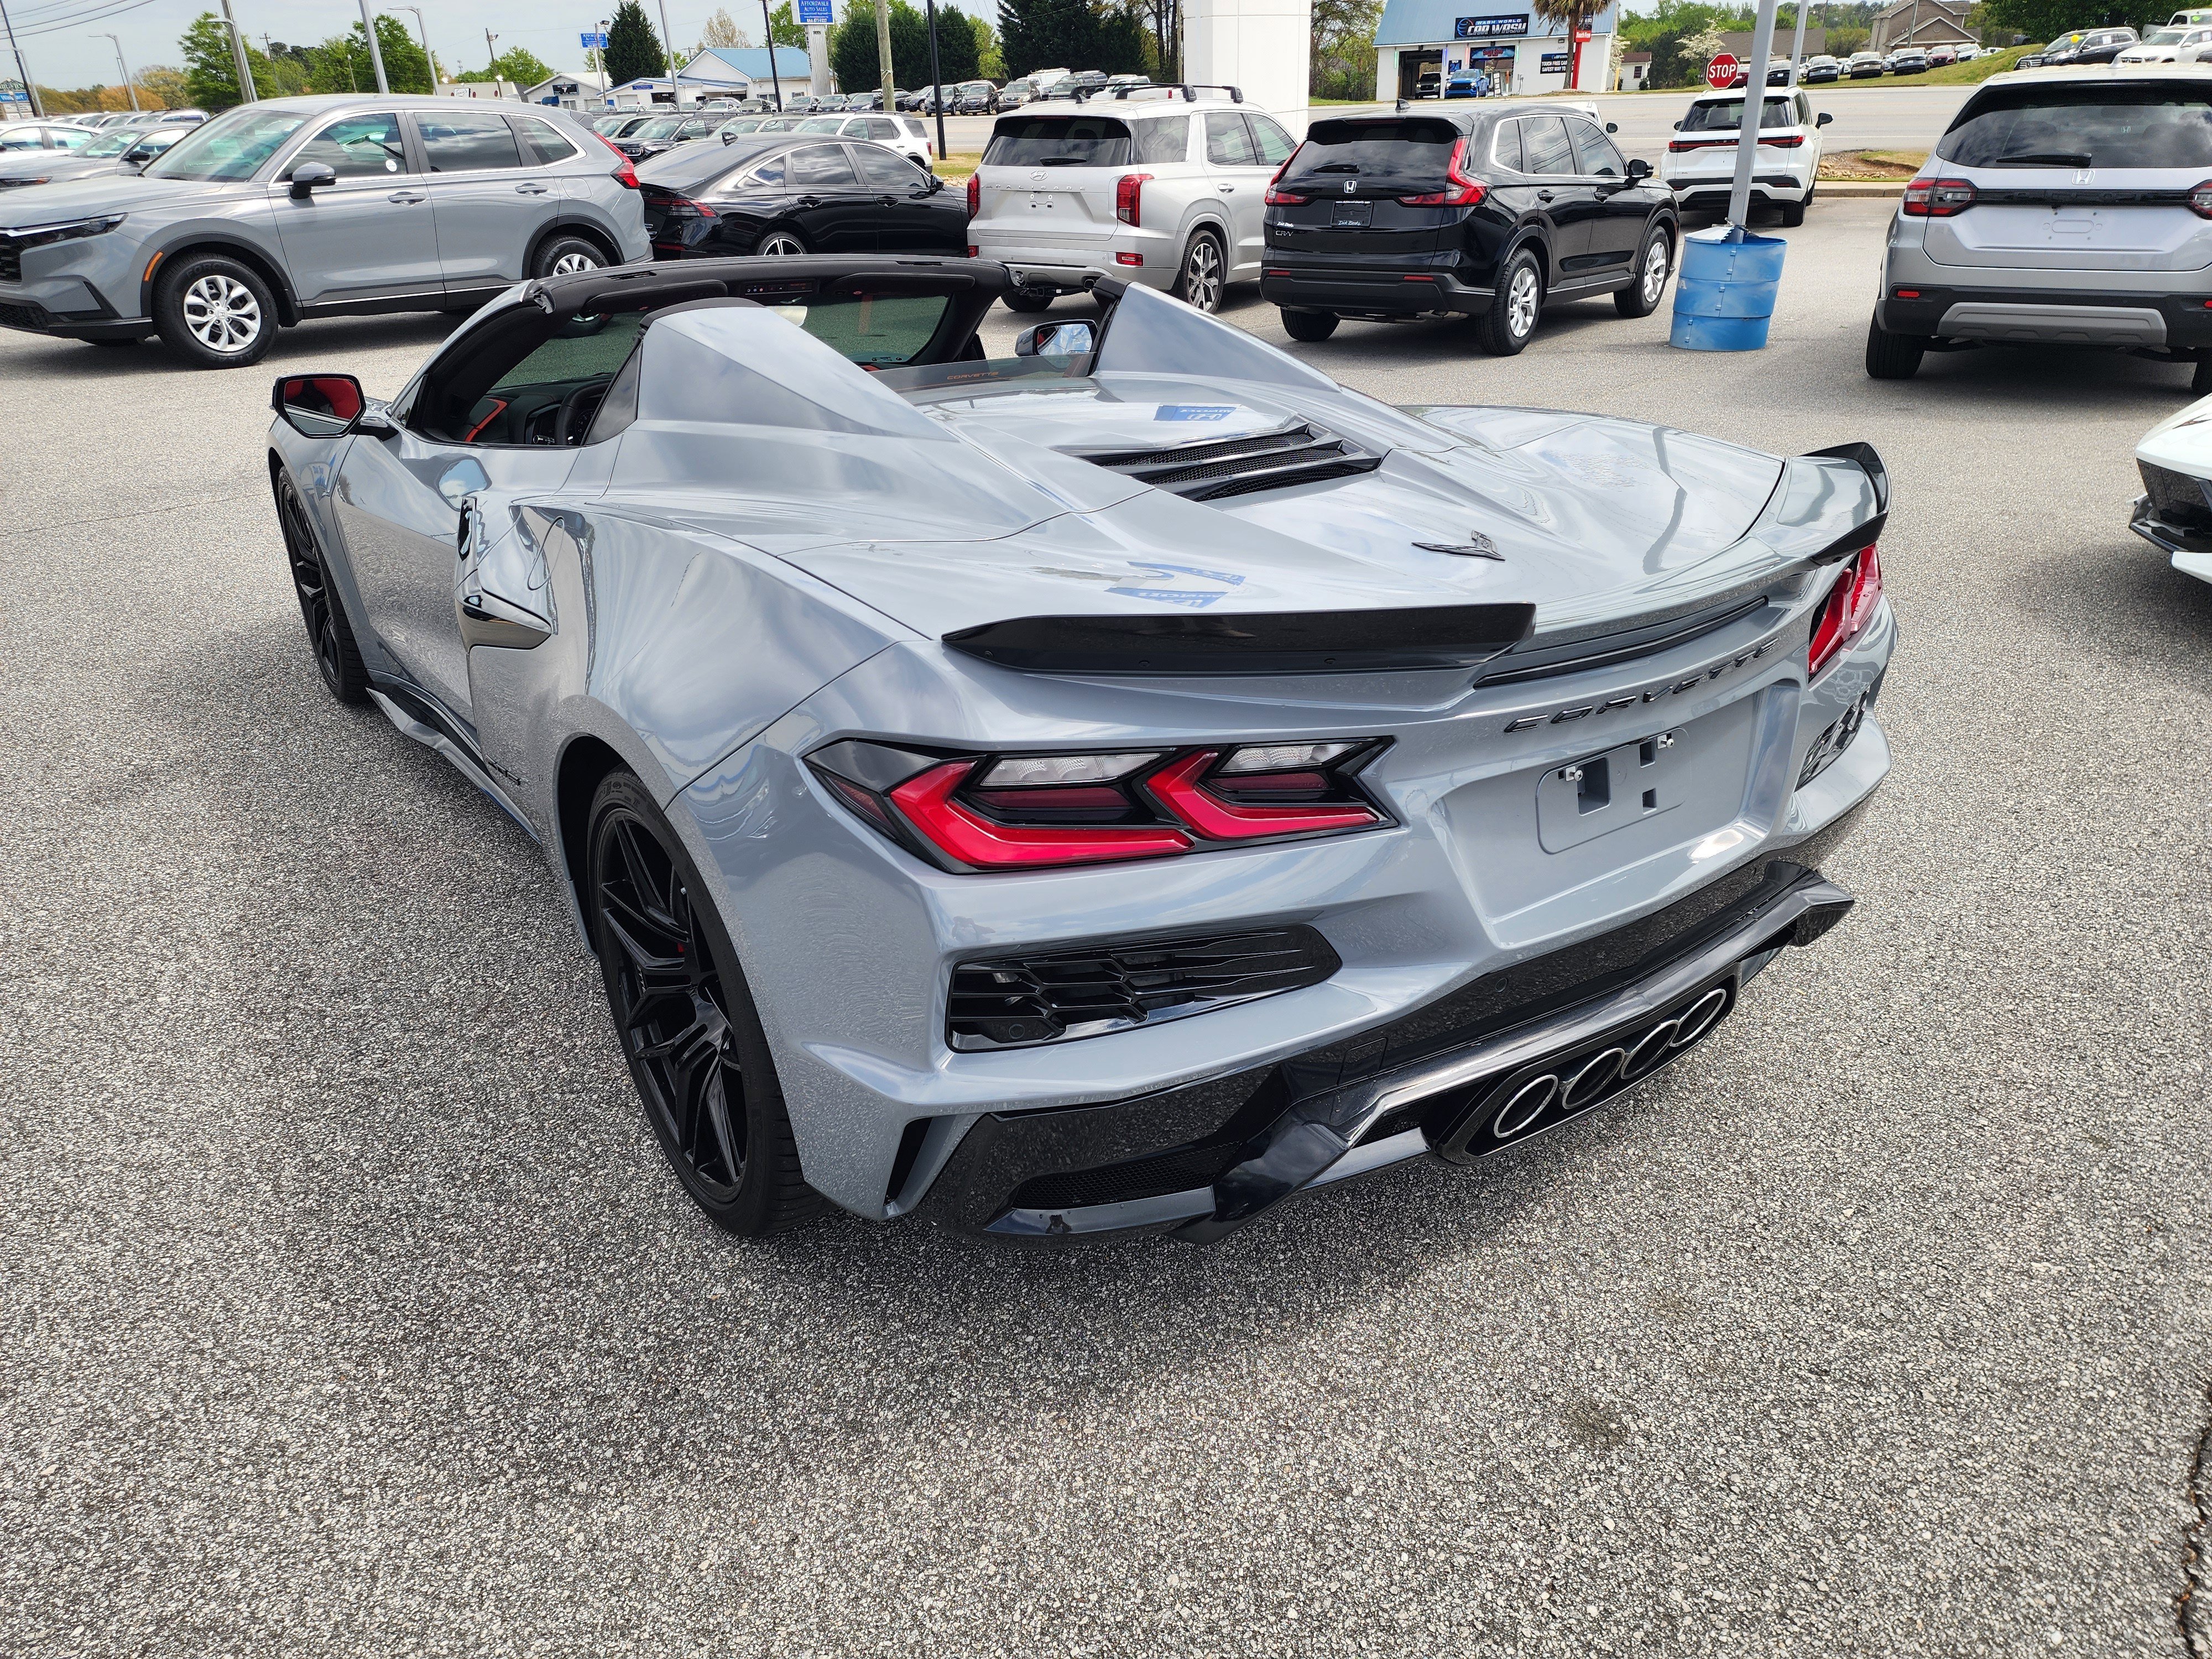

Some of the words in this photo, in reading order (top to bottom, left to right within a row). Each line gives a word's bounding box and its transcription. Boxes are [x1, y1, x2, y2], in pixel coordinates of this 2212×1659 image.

[1467, 25, 1489, 35] CAR
[1491, 23, 1526, 34] WASH
[1449, 63, 1460, 71] 24
[1709, 64, 1736, 79] STOP
[947, 371, 999, 380] CORVETTE
[1504, 638, 1778, 733] CORVETTE
